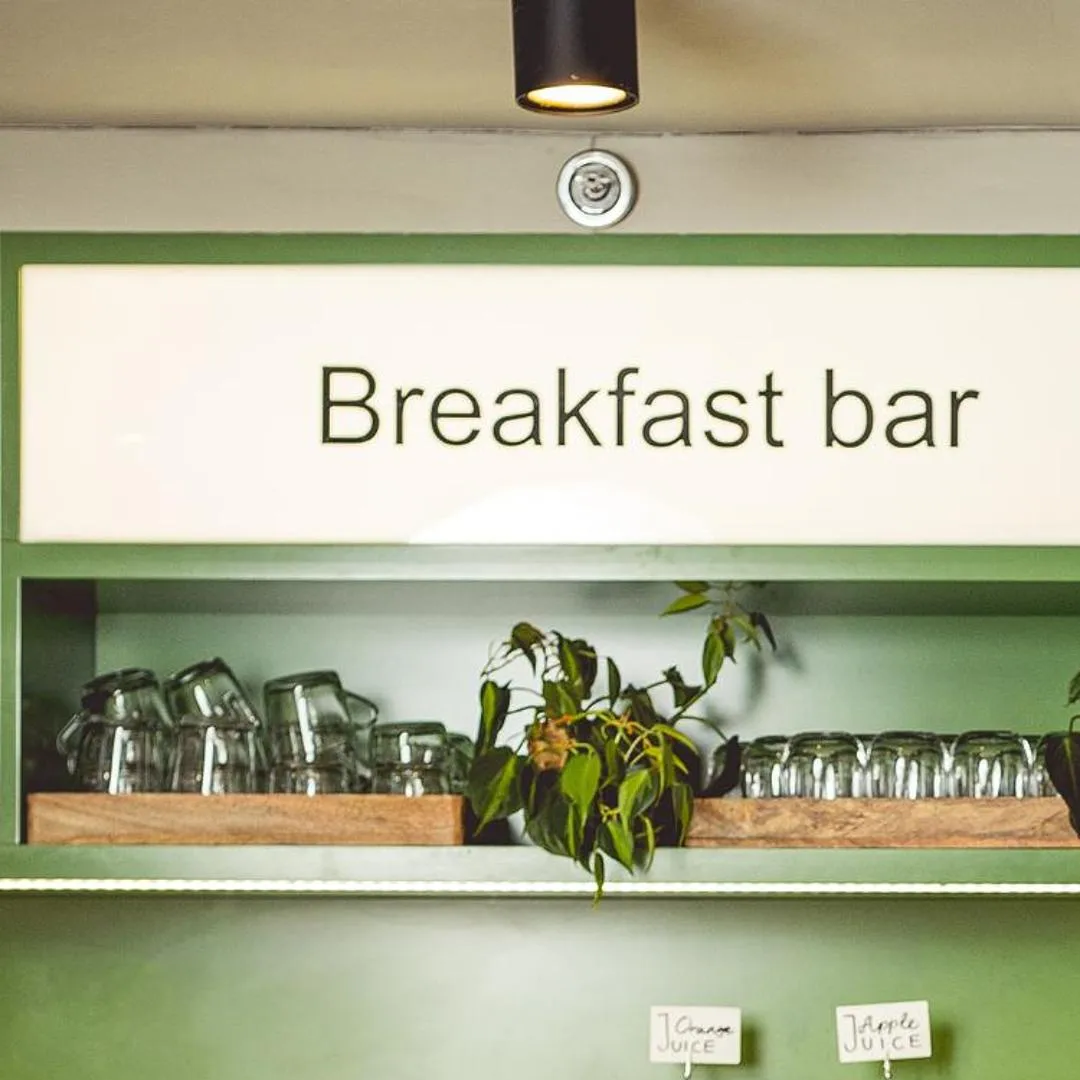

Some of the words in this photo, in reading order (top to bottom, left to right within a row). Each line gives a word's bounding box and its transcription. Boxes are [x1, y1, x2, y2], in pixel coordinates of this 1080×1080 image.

[320, 366, 785, 448] Breakfast
[824, 367, 980, 449] bar
[842, 1013, 923, 1053] JUICE
[858, 1012, 920, 1035] Apple
